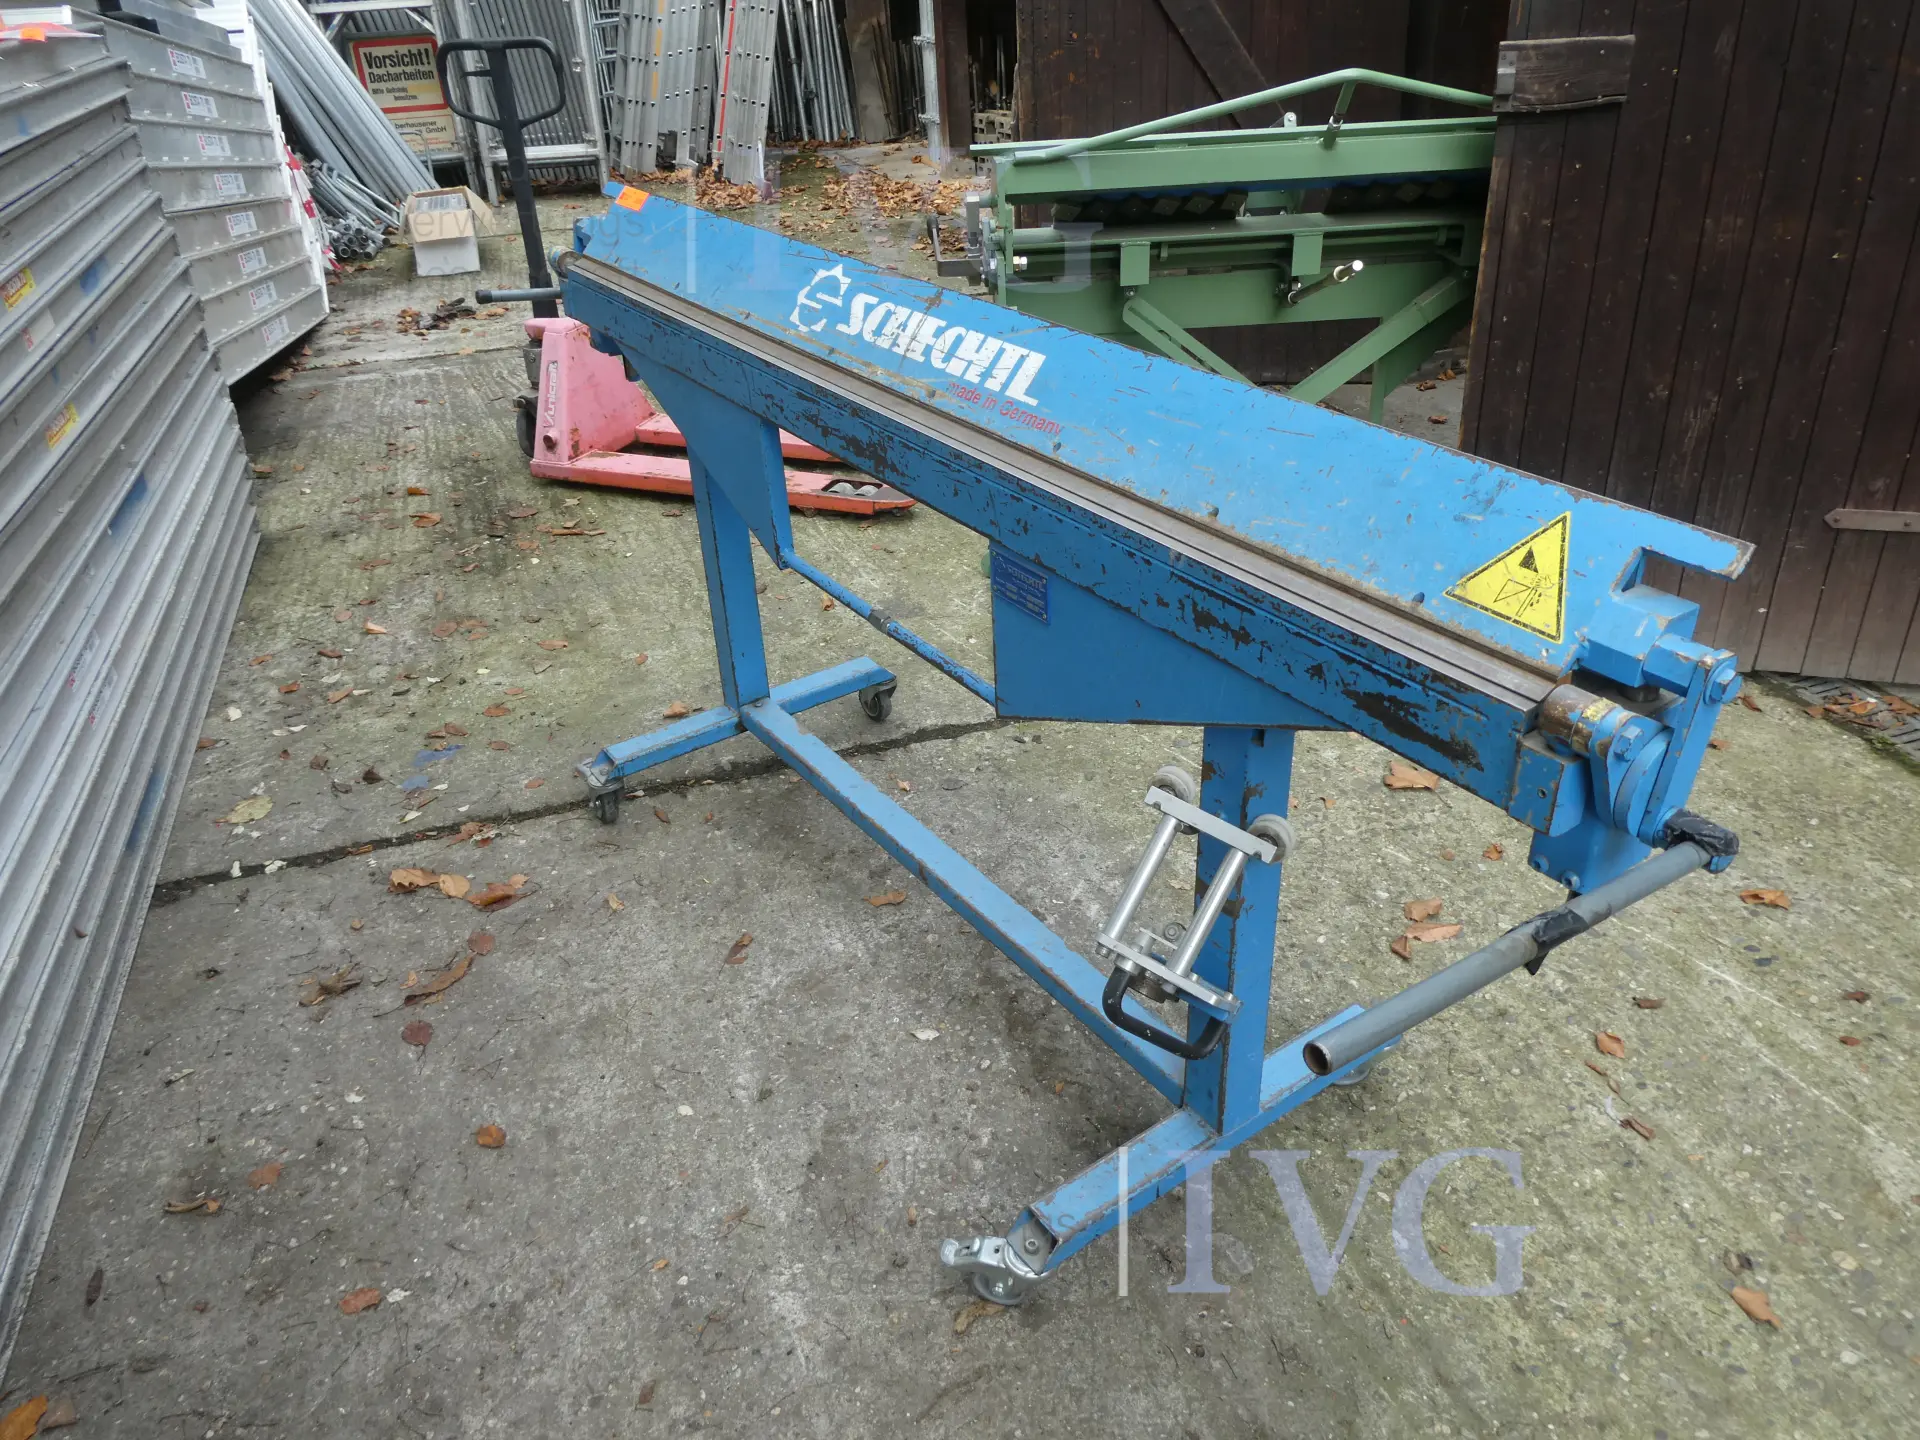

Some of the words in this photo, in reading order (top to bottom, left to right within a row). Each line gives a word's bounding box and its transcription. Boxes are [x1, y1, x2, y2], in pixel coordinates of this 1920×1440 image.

[363, 48, 431, 69] Vorsicht!
[368, 69, 434, 83] Dacharbeiten
[394, 121, 436, 129] berhausener
[426, 125, 447, 133] GmbH
[836, 293, 1046, 406] SCHECHTL
[947, 382, 982, 405] made
[983, 396, 998, 410] in
[1000, 400, 1065, 436] Germany
